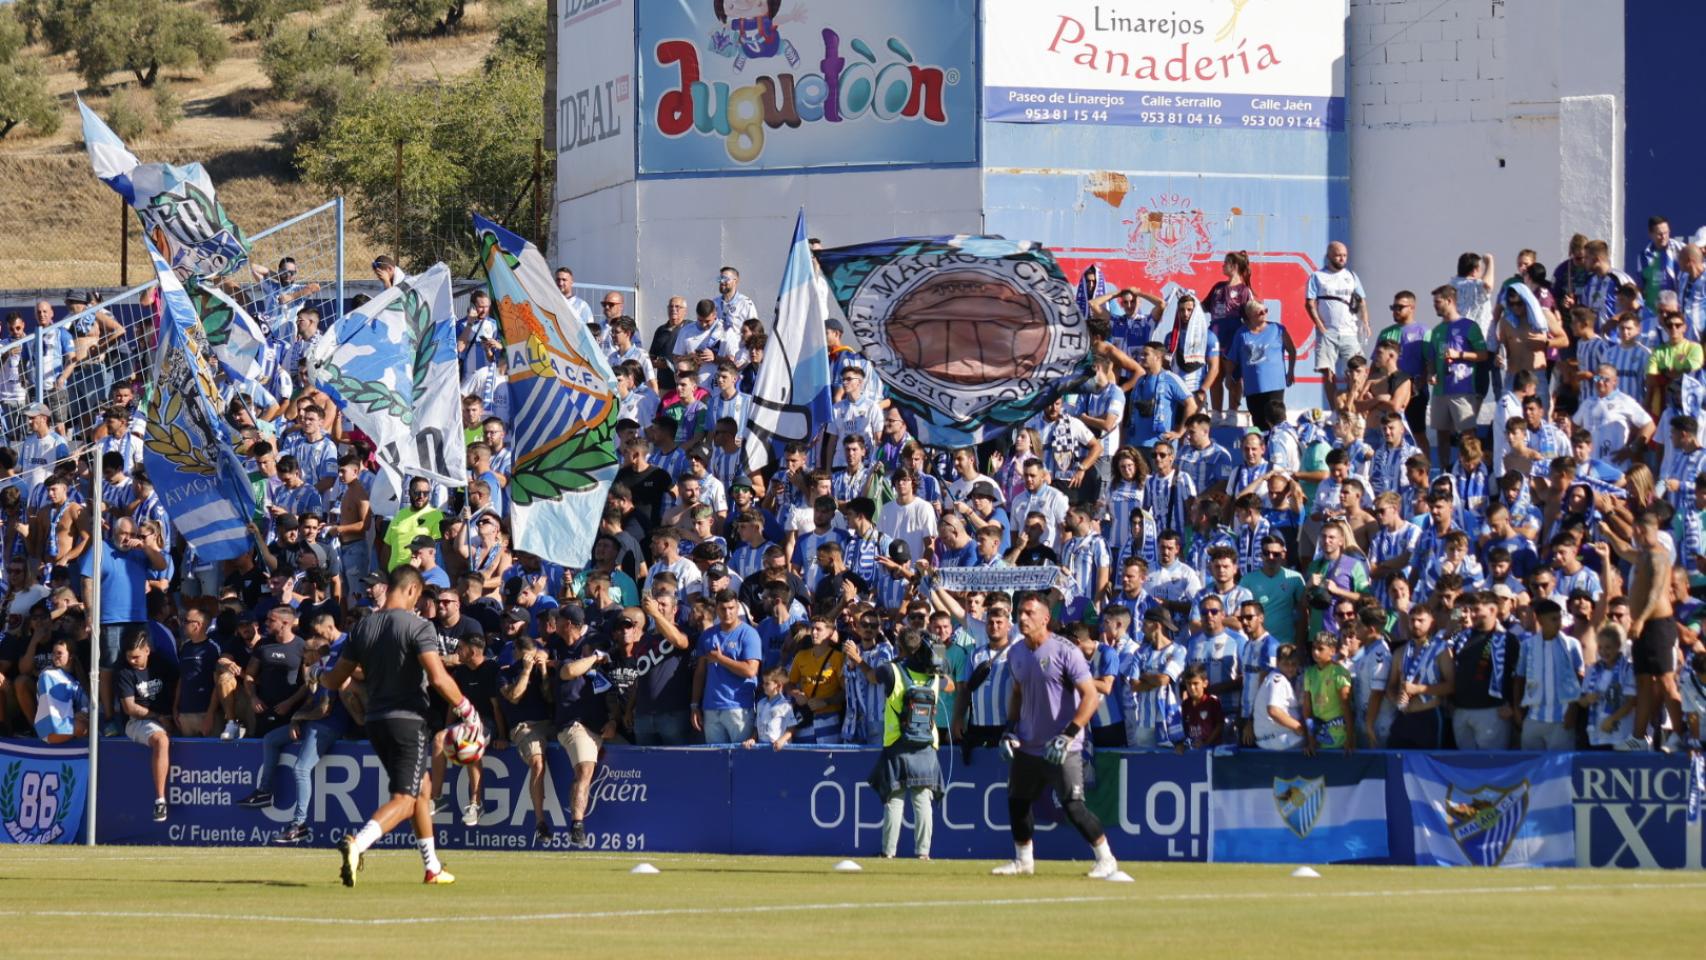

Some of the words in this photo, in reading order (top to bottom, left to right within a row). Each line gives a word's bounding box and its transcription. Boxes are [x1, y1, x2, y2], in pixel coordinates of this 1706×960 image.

[1095, 6, 1205, 39] Linarejos
[1047, 15, 1281, 82] Panadería
[1008, 91, 1046, 103] Paseo
[1048, 92, 1065, 104] de
[1068, 92, 1126, 108] Linarejos
[1141, 95, 1172, 106] Calle
[1175, 96, 1222, 109] Serrallo
[1251, 98, 1281, 110] Calle
[1283, 98, 1312, 111] Jaén
[559, 80, 621, 154] IDEAL
[1025, 108, 1050, 120] 953
[1052, 109, 1068, 121] 81
[1074, 109, 1089, 121] 15
[1091, 110, 1108, 122] 44
[1140, 111, 1165, 123] 953
[1168, 112, 1183, 124] 81
[1187, 113, 1204, 125] 04
[1207, 114, 1222, 126] 16
[1241, 115, 1265, 127] 953
[1268, 115, 1284, 127] 00
[1287, 115, 1301, 127] 91
[1305, 117, 1321, 128] 44
[1150, 193, 1191, 209] 1890
[169, 765, 253, 785] Panadería
[600, 764, 642, 781] Degusta
[19, 771, 59, 830] 86
[169, 786, 232, 806] Bollería
[584, 777, 648, 817] Jaén
[4, 820, 63, 845] MALAGA
[168, 824, 186, 841] C/
[191, 825, 246, 842] Fuente
[439, 830, 449, 846] 8
[465, 830, 527, 847] Linares
[600, 833, 621, 849] 26
[626, 834, 645, 850] 91
